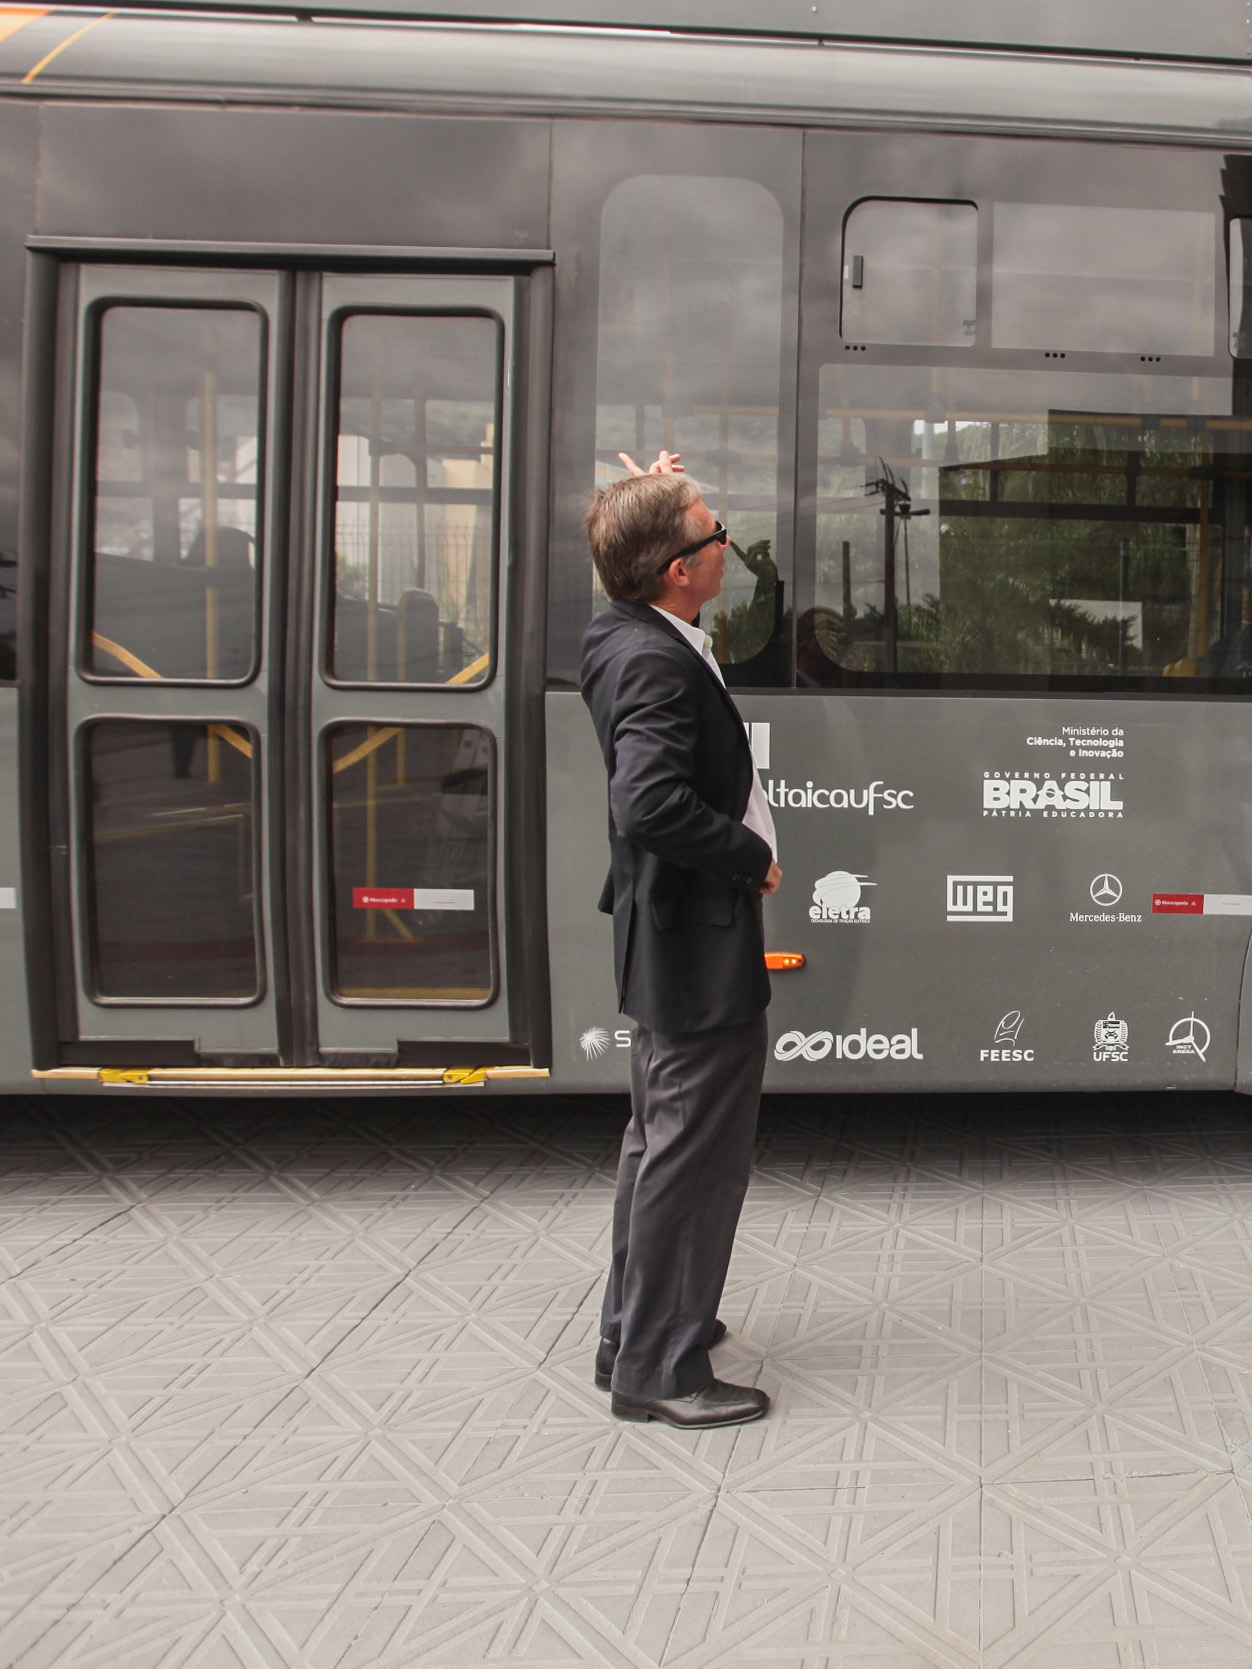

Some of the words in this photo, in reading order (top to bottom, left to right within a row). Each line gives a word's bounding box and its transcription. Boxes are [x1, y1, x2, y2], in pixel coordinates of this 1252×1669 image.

[1062, 727, 1109, 736] Ministério
[1111, 727, 1125, 736] da
[1026, 737, 1067, 747] Ciência,
[1069, 737, 1125, 748] Tecnologia
[1069, 749, 1076, 757] e
[1078, 748, 1125, 759] Inovação
[983, 771, 1051, 779] GOVERNO
[1061, 772, 1125, 780] FEDERAL
[983, 779, 1124, 810] BRASIL
[983, 809, 1032, 818] PÁTRIA
[1043, 810, 1124, 818] EDUCADORA
[808, 903, 871, 920] eletra
[1069, 912, 1142, 924] Mercedes-Benz
[836, 1027, 924, 1060] ideal
[979, 1049, 1035, 1062] FEESC
[1093, 1051, 1129, 1062] UFSC
